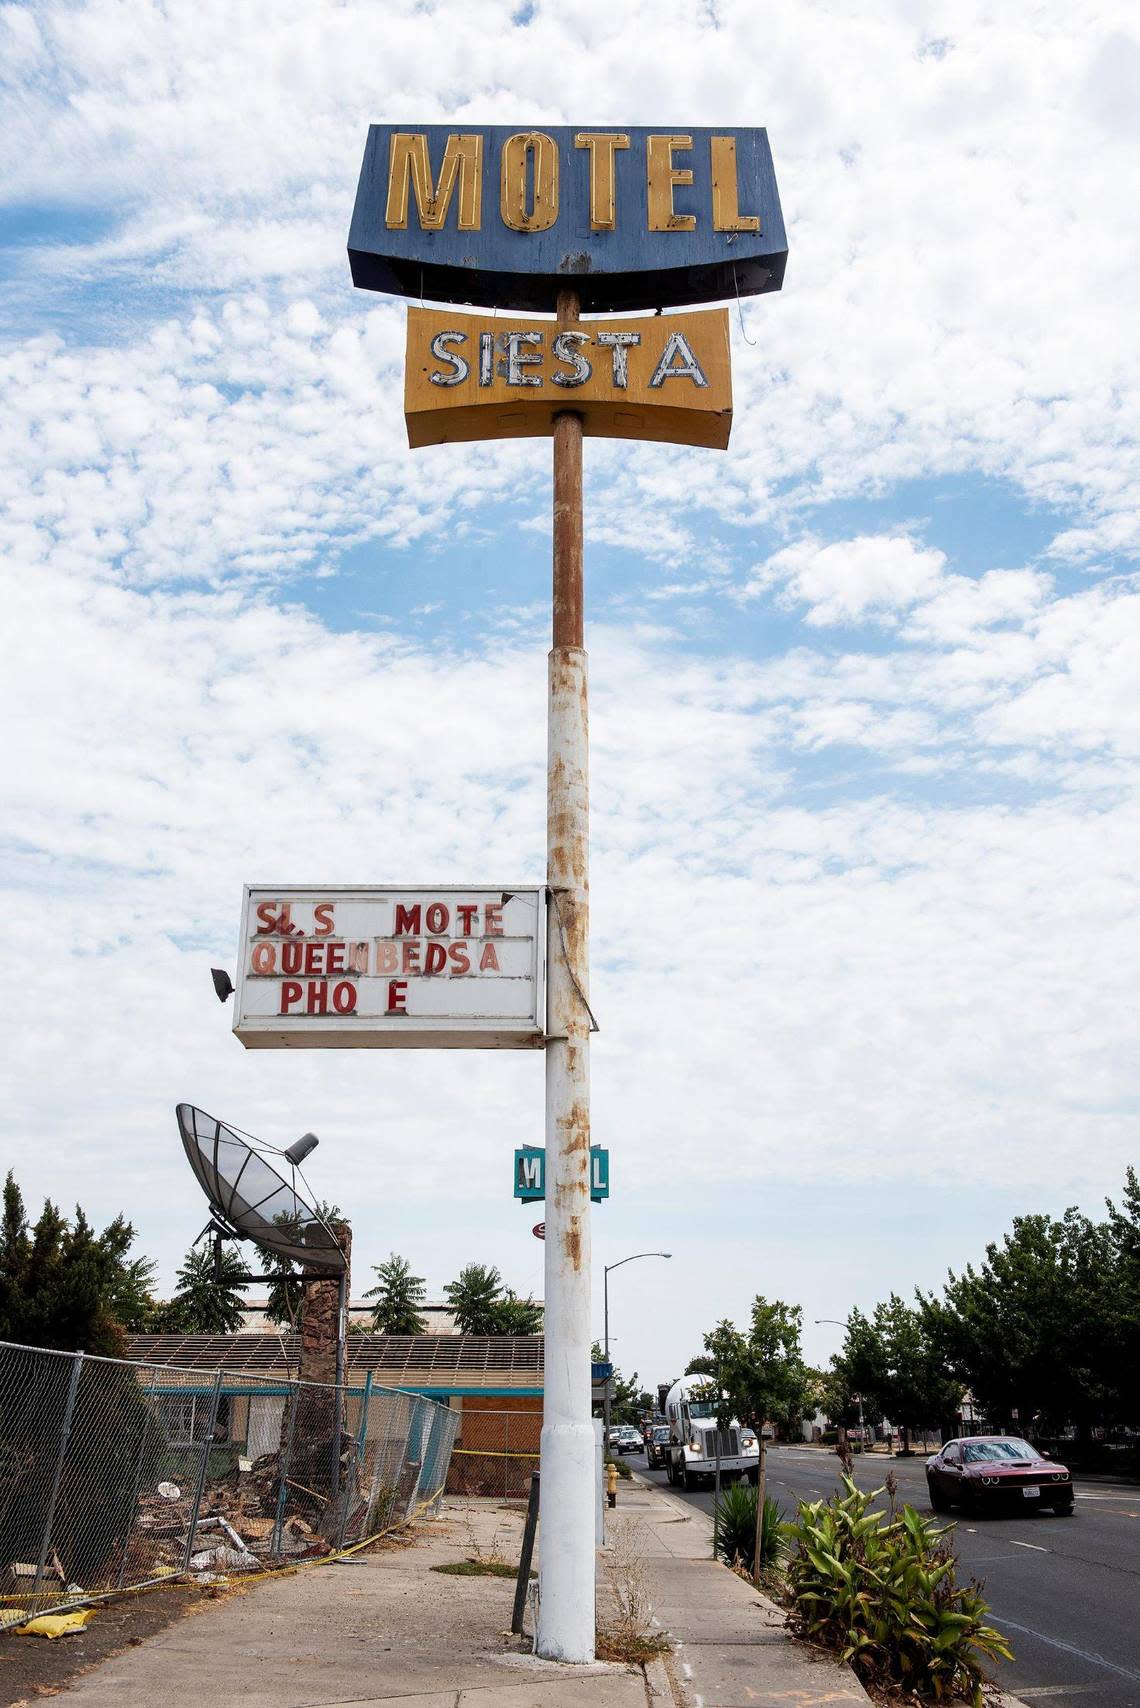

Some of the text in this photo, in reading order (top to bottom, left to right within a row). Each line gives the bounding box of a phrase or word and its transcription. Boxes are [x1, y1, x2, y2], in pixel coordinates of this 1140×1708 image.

[385, 132, 761, 233] MOTEL
[429, 331, 710, 390] SIESTA
[396, 903, 504, 936] MOTE
